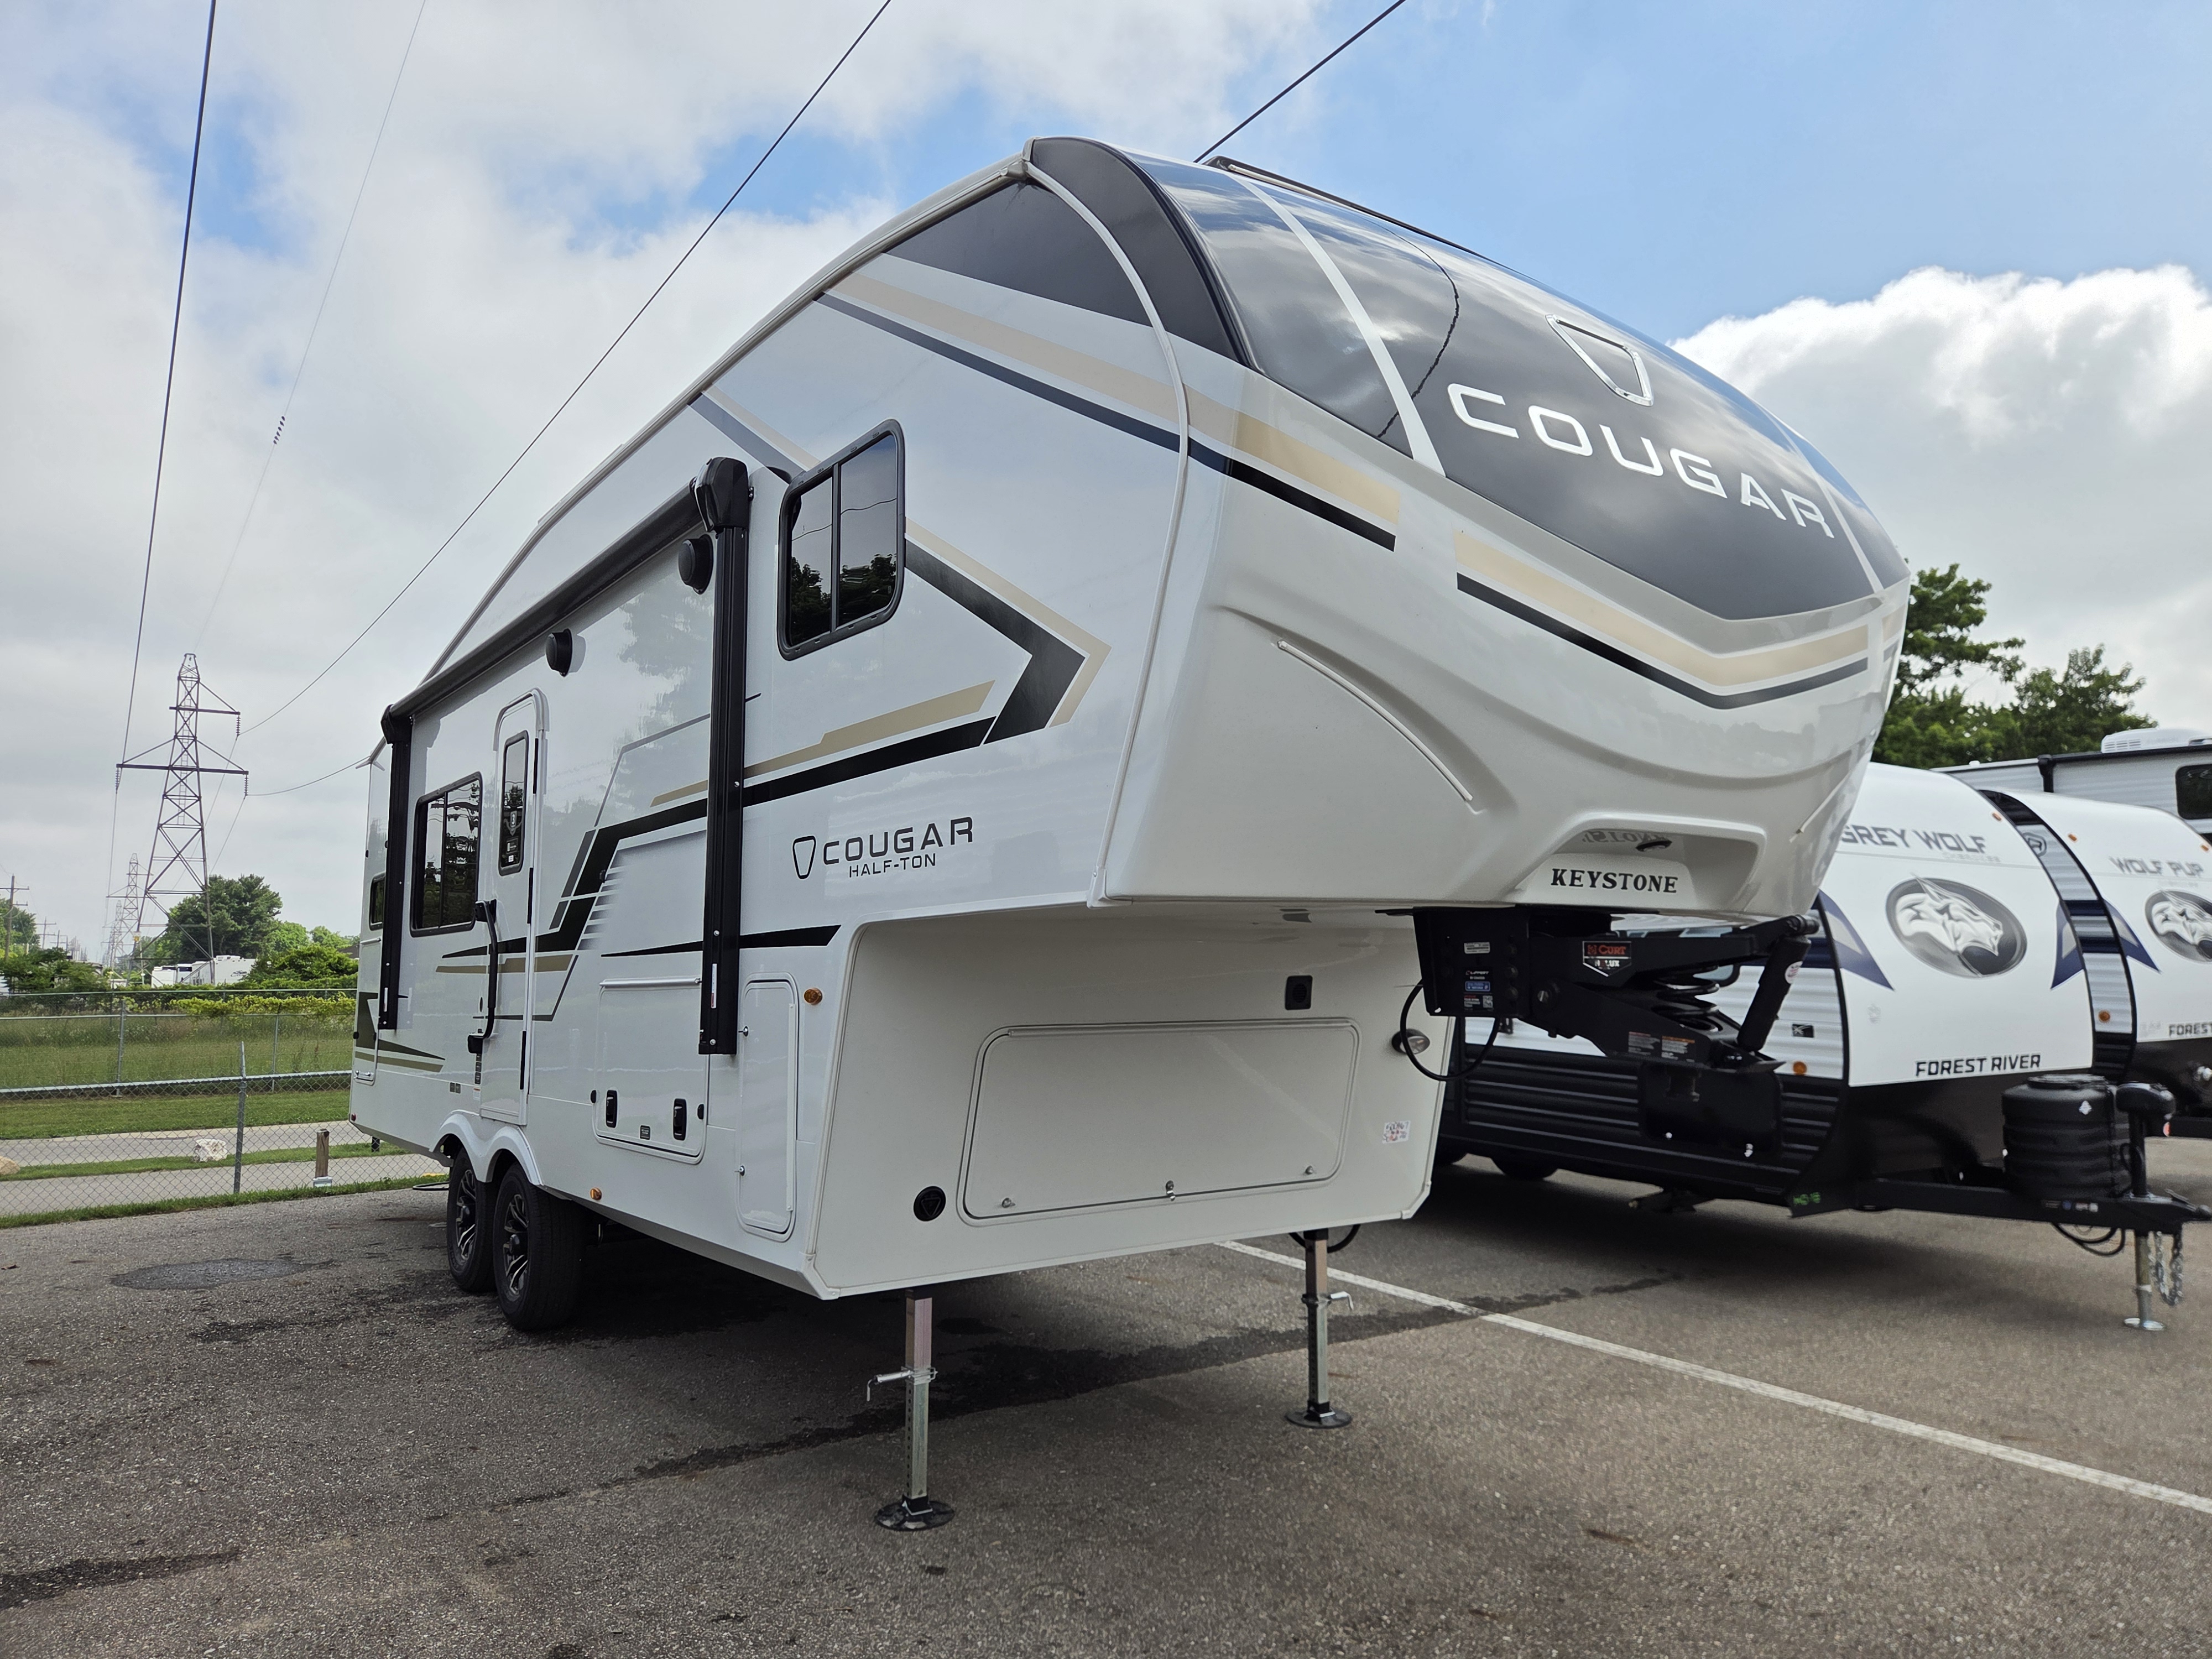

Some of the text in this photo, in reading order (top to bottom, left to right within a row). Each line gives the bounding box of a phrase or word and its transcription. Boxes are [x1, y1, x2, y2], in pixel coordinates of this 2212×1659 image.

[1447, 383, 1835, 539] COUGAR
[823, 816, 973, 865] COUGAR
[1912, 830, 1986, 853] WOLF
[849, 853, 936, 878] HALF-TON
[2108, 856, 2204, 878] WOLF PUP
[1550, 868, 1678, 894] KEYSTONE
[1916, 1055, 2041, 1077] FOREST RIVER
